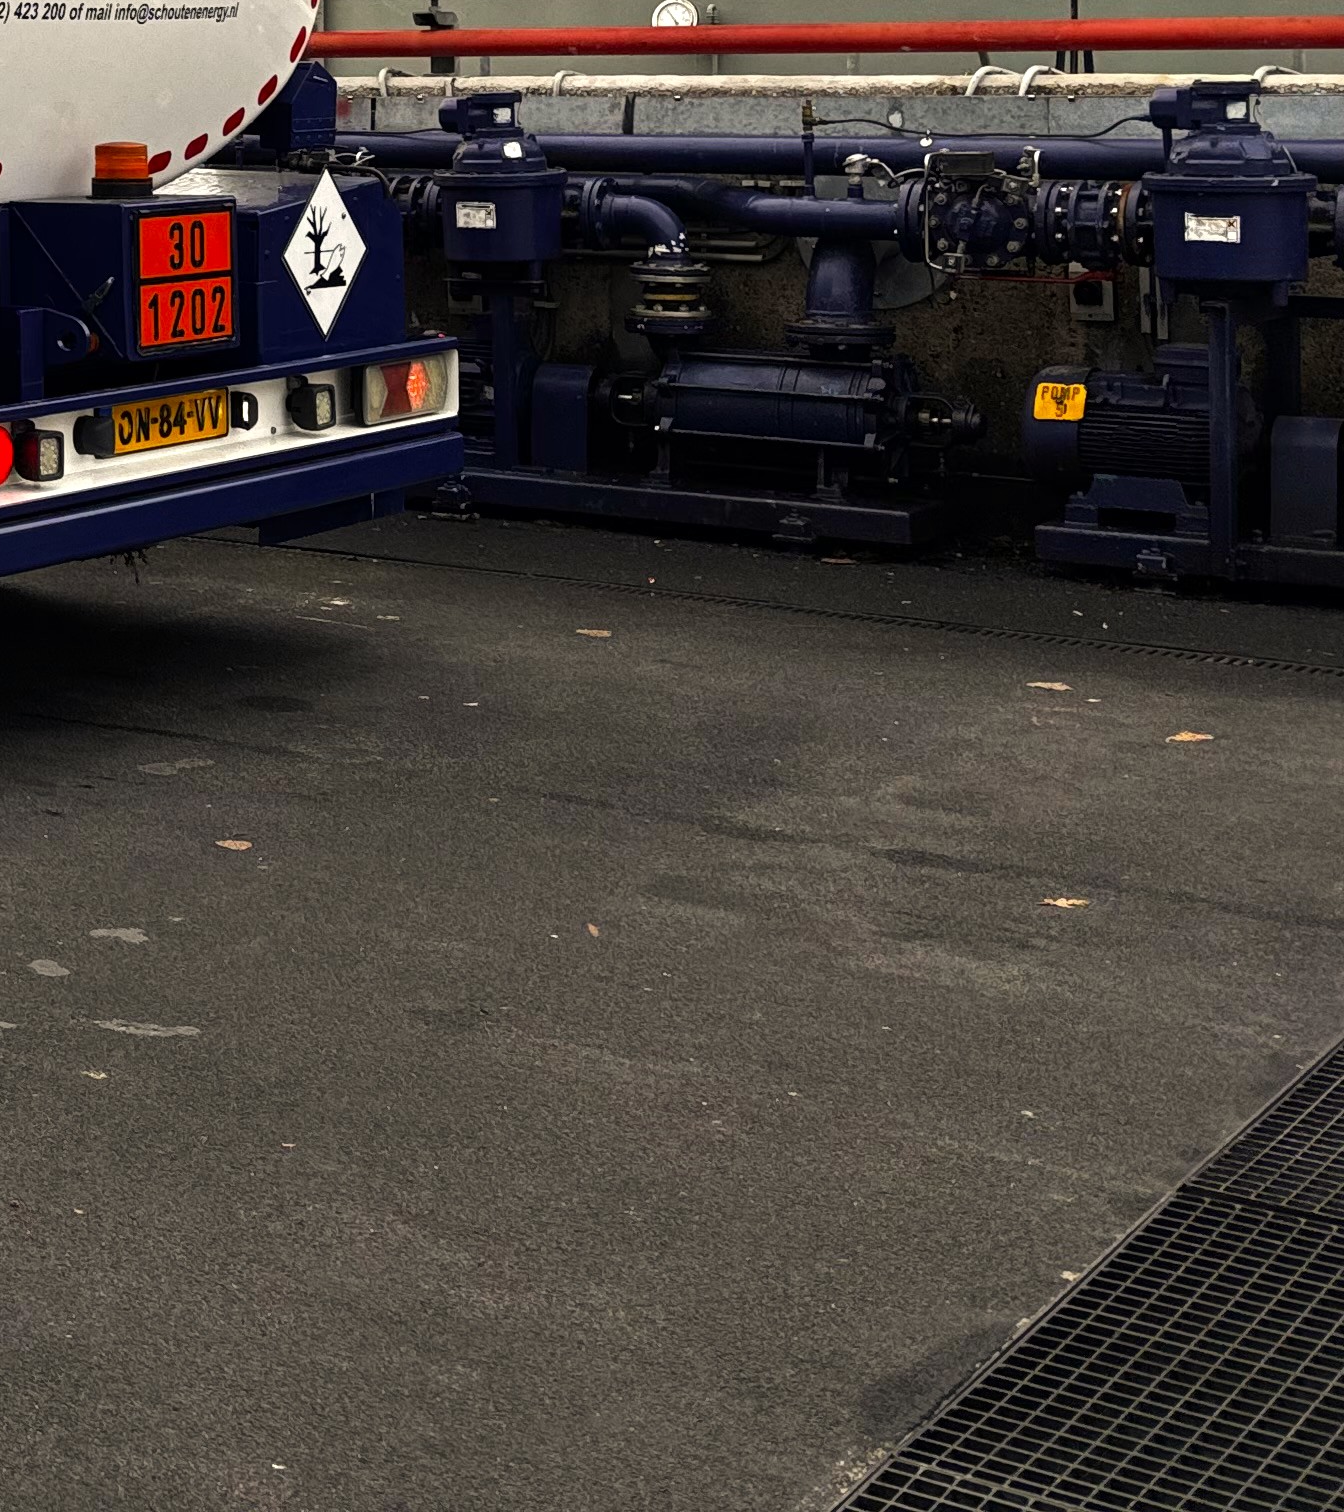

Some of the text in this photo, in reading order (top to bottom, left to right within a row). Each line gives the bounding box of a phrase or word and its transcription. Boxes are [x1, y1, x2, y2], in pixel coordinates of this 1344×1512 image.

[13, 2, 40, 20] 423
[41, 2, 67, 21] 200
[69, 2, 85, 21] of
[84, 3, 113, 21] mail
[113, 1, 240, 25] info@schoutenenergy.nl
[168, 220, 205, 270] 30
[147, 285, 226, 341] 1202
[118, 394, 222, 446] ON-84-VV
